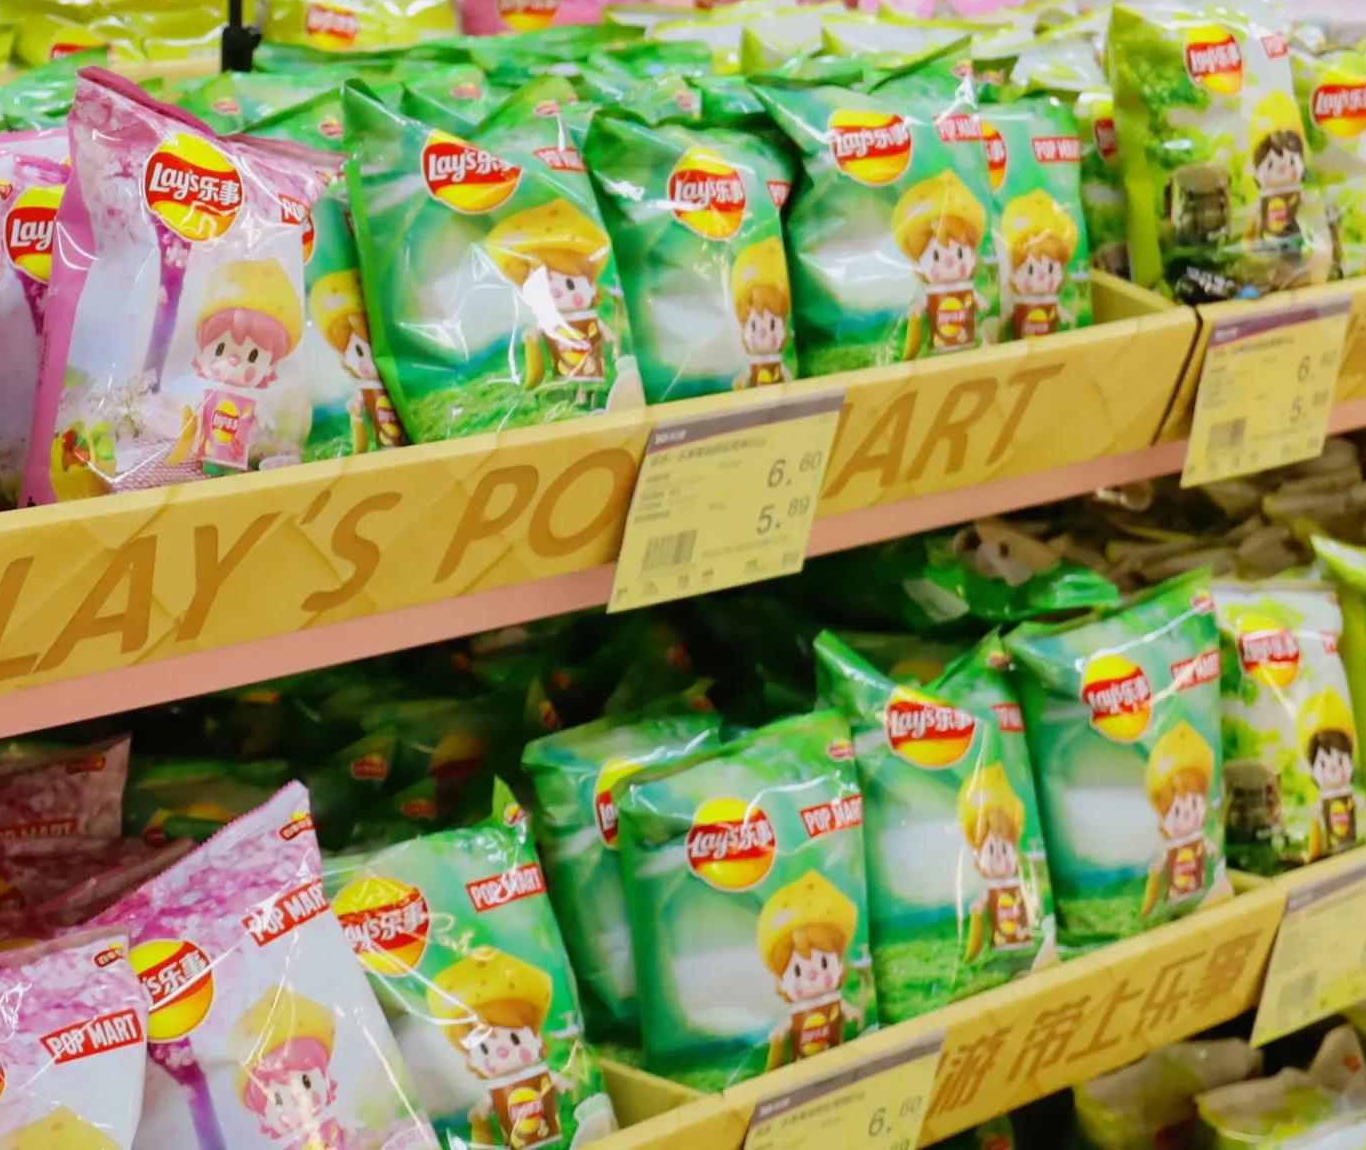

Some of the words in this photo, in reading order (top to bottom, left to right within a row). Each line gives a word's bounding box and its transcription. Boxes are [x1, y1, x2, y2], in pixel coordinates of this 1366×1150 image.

[435, 442, 637, 584] PO
[46, 1029, 90, 1059] POP
[92, 1013, 137, 1049] MART
[1008, 931, 1260, 1082] 带上乐事
